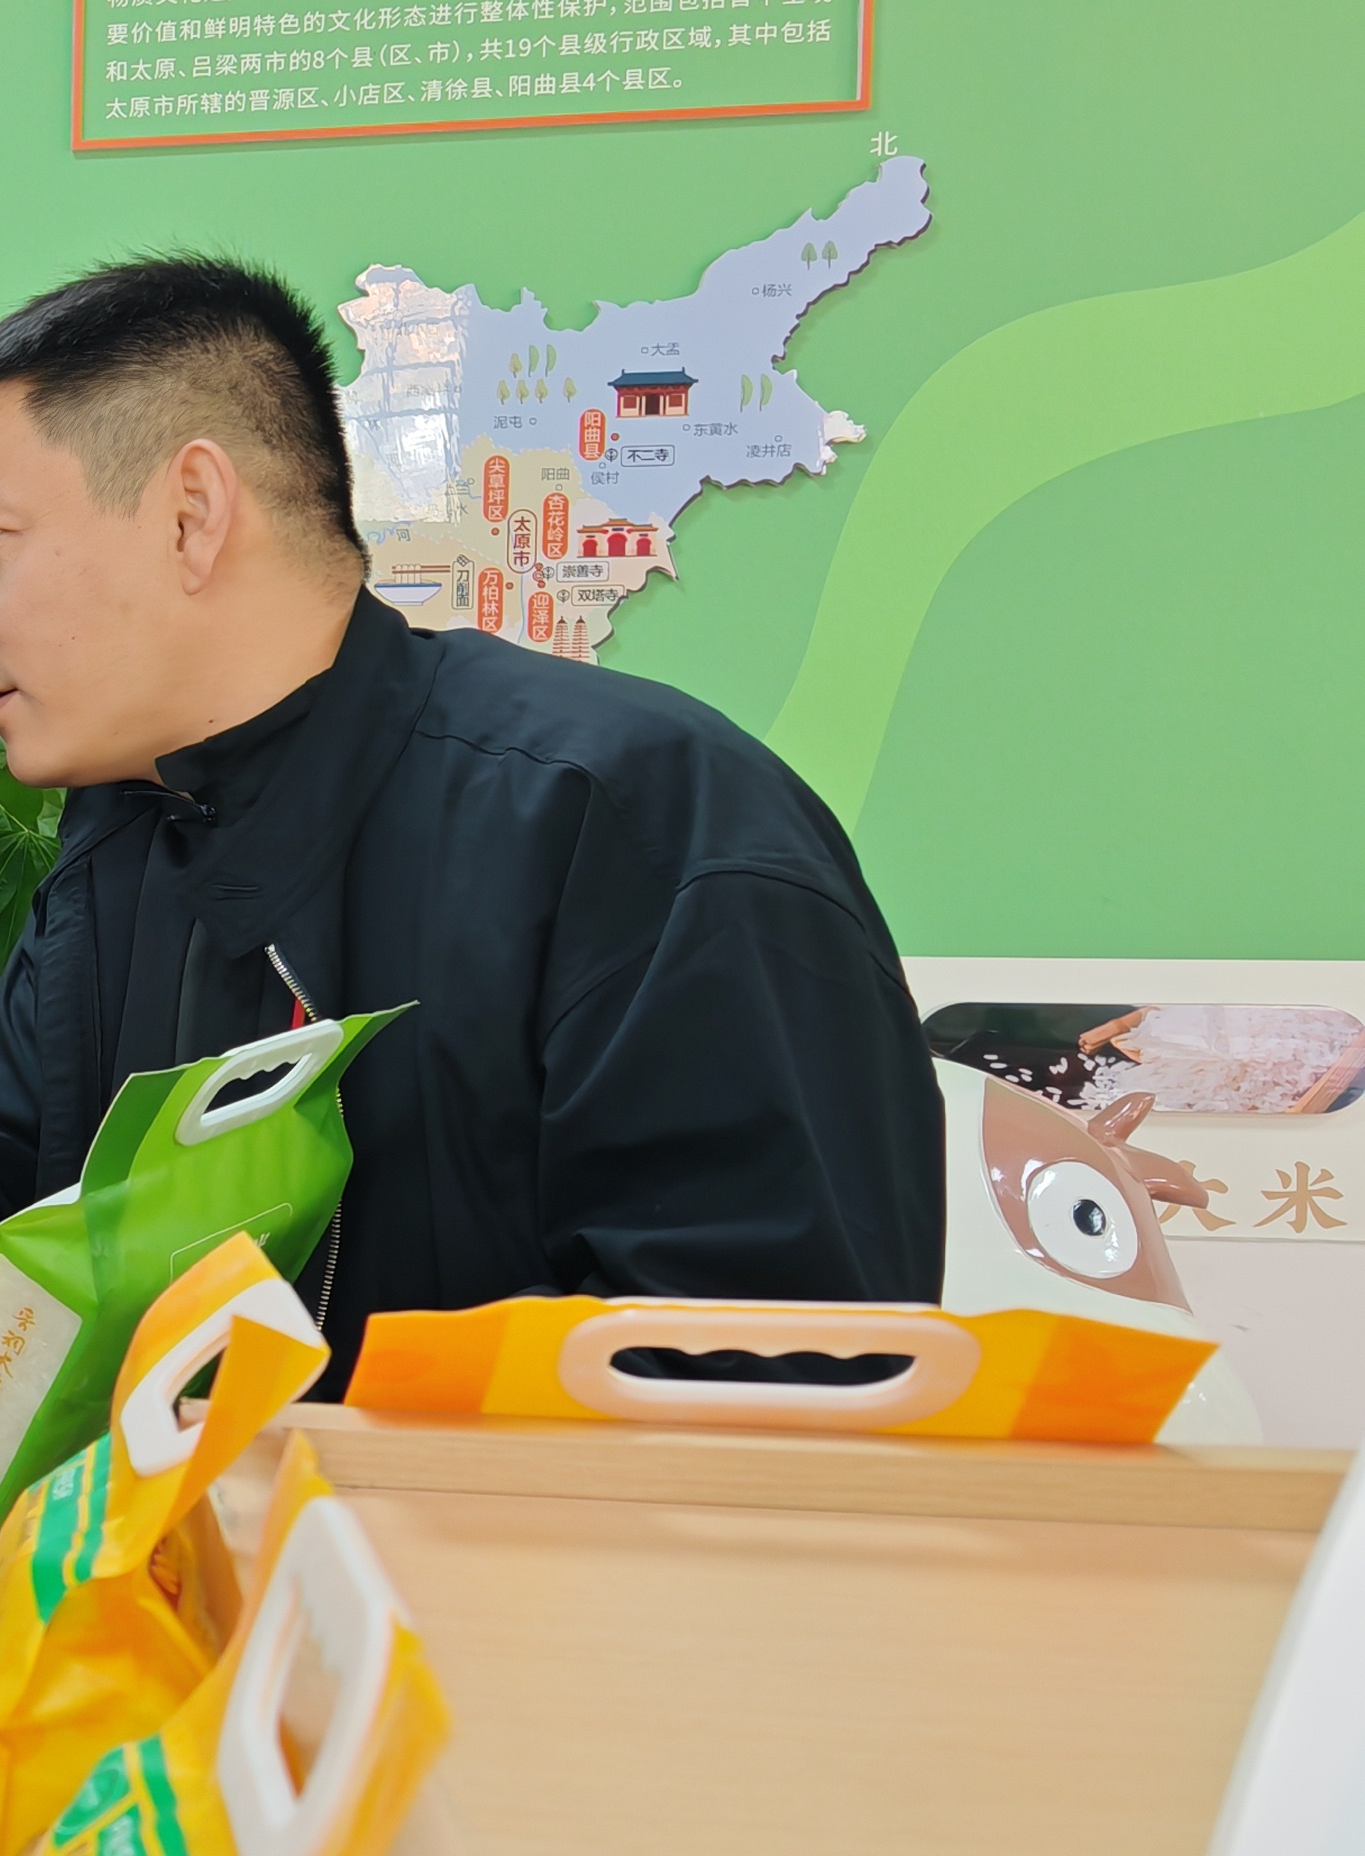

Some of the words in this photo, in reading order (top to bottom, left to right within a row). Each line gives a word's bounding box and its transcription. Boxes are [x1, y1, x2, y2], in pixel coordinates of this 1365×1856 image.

[870, 131, 898, 157] 北
[762, 283, 792, 298] 杨兴
[493, 415, 523, 430] 泥屯
[693, 421, 738, 437] 东黄水
[584, 411, 601, 459] 阳曲县
[627, 448, 669, 462] 不二寺
[541, 467, 570, 482] 阳曲
[591, 471, 619, 485] 侯村
[488, 457, 506, 521] 尖草坪区
[546, 494, 565, 558] 杏花岭区
[513, 516, 532, 568] 太原市
[562, 564, 604, 578] 崇善寺
[482, 570, 499, 632] 万柏林区
[577, 588, 619, 602] 双塔寺
[532, 593, 551, 641] 迎泽区
